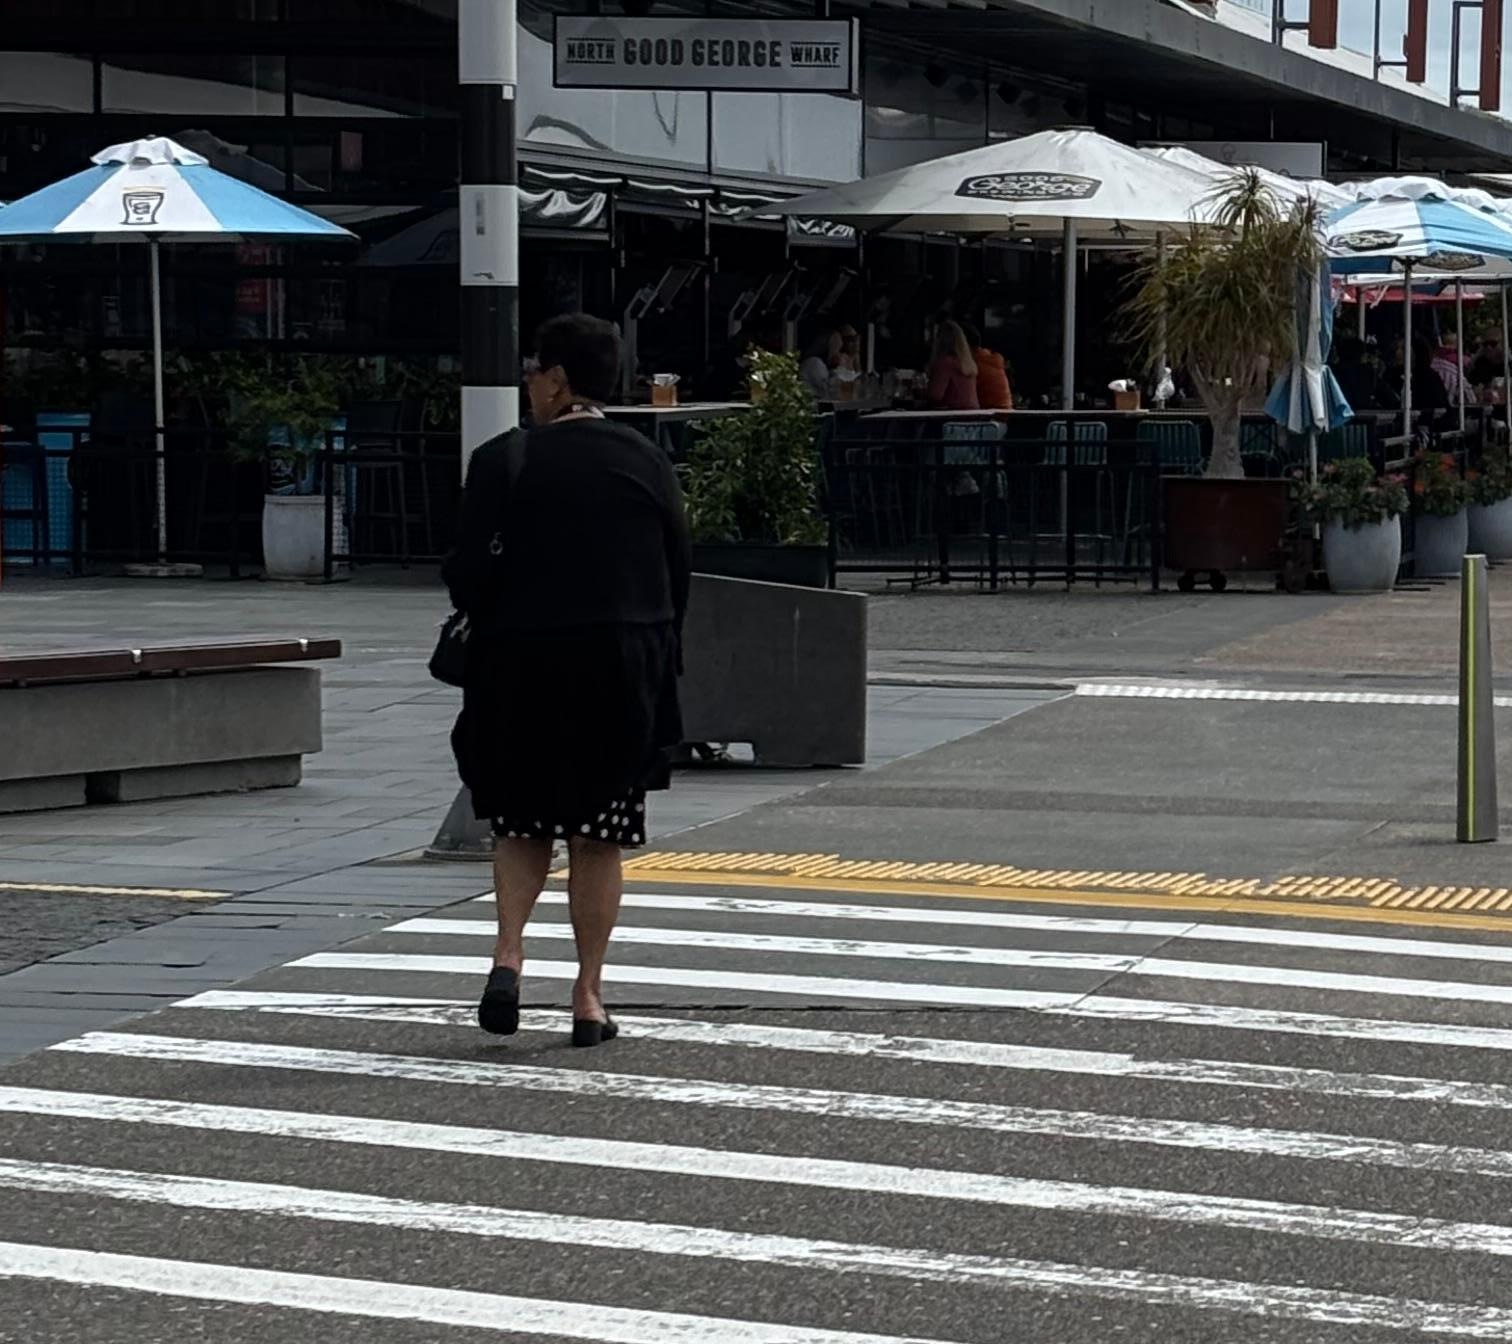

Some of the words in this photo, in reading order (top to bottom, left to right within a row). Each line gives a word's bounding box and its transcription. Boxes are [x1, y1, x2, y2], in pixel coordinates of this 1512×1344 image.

[567, 42, 615, 60] NORTH
[623, 38, 684, 66] GOOD
[691, 38, 782, 68] GEORGE
[790, 46, 840, 63] WHARF
[968, 177, 1092, 194] George
